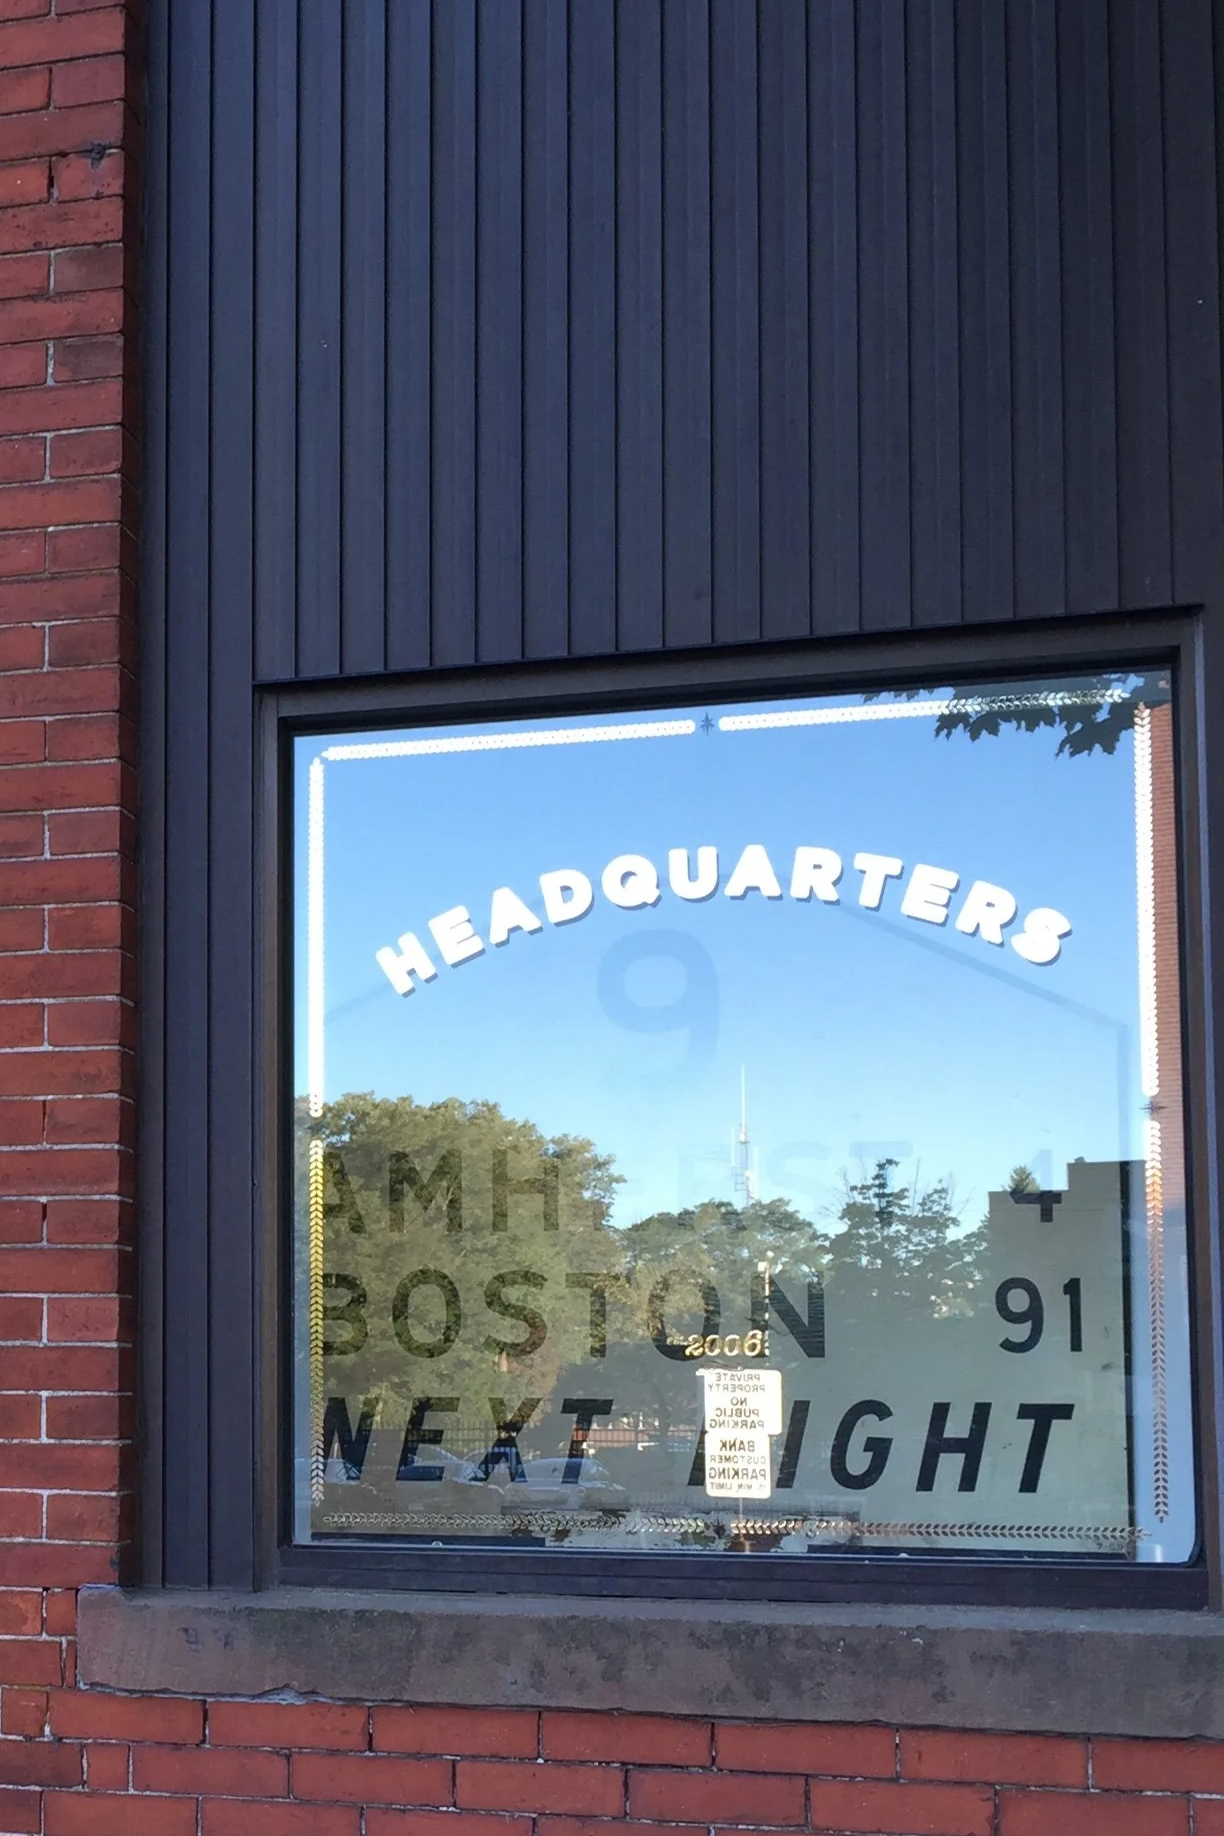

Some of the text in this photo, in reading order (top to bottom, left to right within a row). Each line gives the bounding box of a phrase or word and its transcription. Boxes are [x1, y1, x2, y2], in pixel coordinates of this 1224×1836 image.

[375, 843, 1073, 997] HEADQUARTERS
[597, 929, 720, 1068] 9
[1008, 1148, 1063, 1224] 4
[323, 1267, 1083, 1360] BOSTON 91
[685, 1330, 763, 1357] 2006
[323, 1397, 1074, 1494] NEXT IGHT
